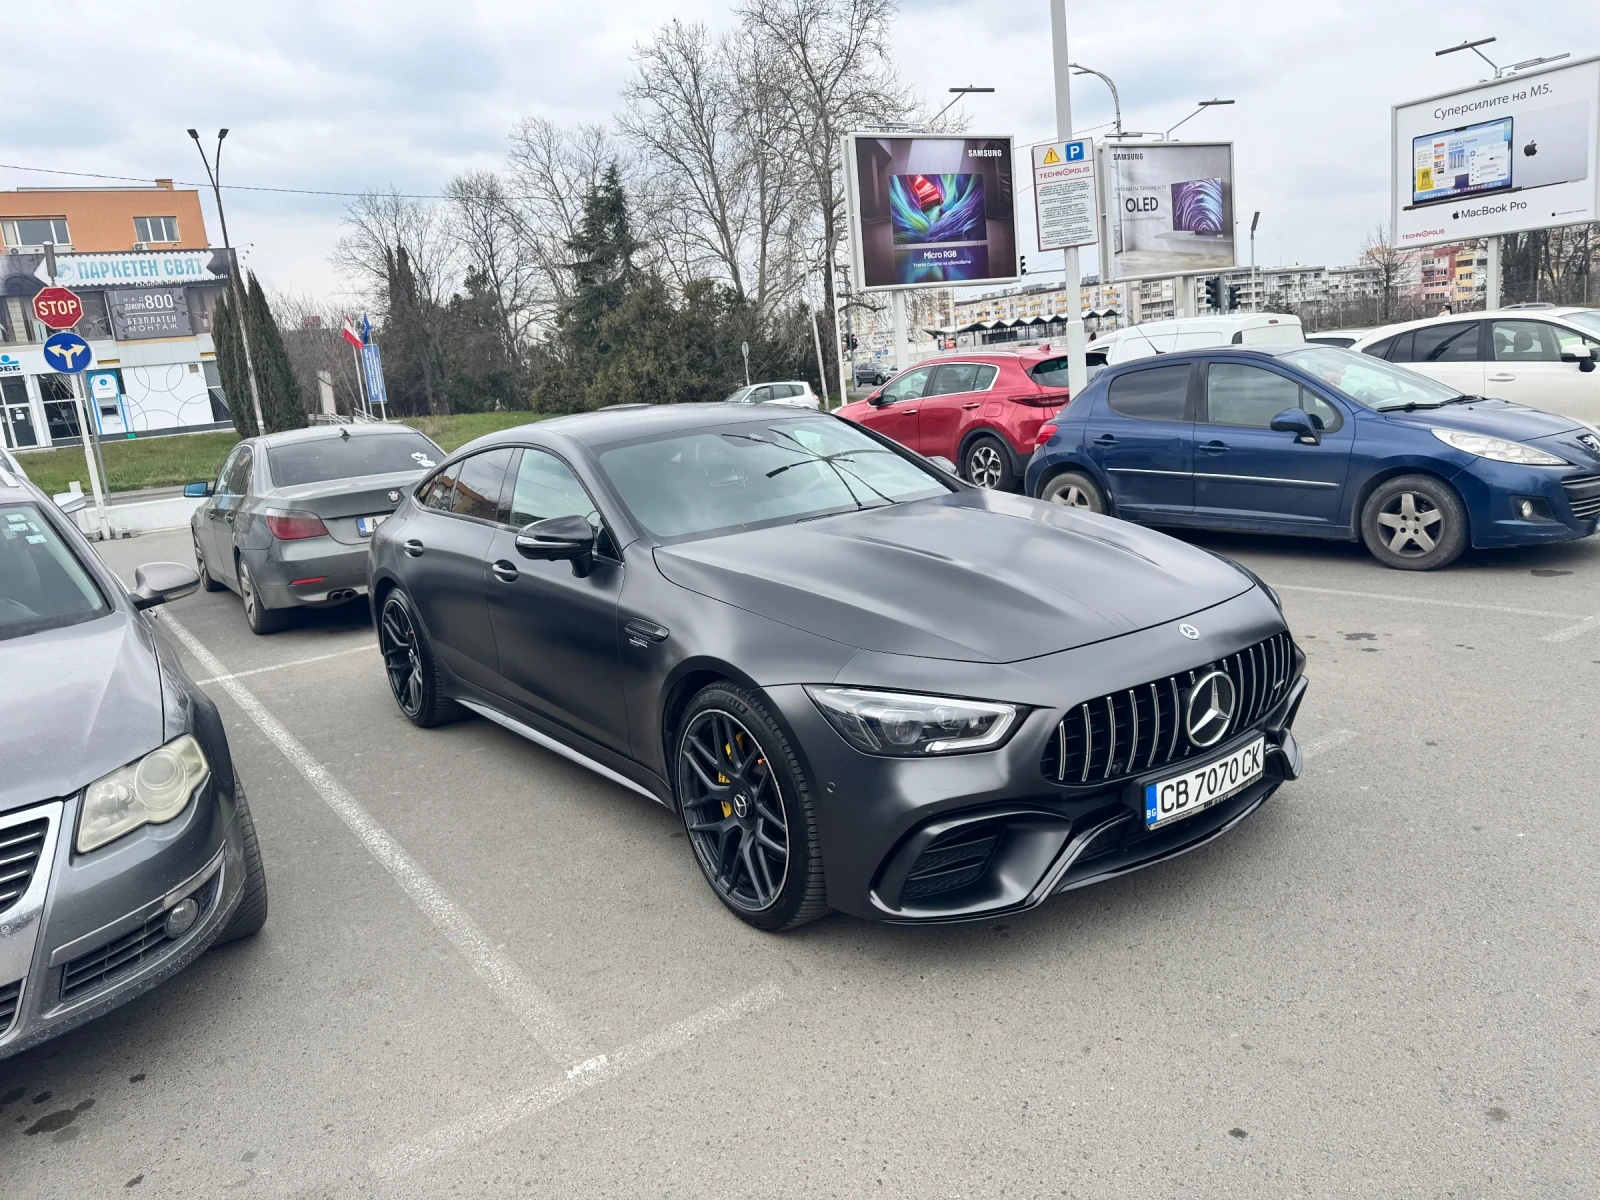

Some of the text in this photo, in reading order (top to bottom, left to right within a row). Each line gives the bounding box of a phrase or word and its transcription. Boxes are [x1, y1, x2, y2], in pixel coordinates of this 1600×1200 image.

[1433, 94, 1509, 121] Суперсилите
[1512, 92, 1527, 101] на
[967, 149, 1002, 157] SAMSUNG
[1113, 153, 1144, 161] SAMSUNG
[1039, 166, 1090, 179] TECHNOPOLIS
[1125, 196, 1159, 213] OLED
[1460, 200, 1528, 219] MacBook Pro
[1402, 228, 1445, 240] TECHNOPOLIS
[923, 250, 957, 259] Micro RGB
[77, 260, 159, 280] ПАРКЕТЕН
[163, 257, 203, 275] СВЯТ
[145, 293, 174, 309] 800
[38, 300, 77, 316] STOP
[127, 315, 177, 325] БЕЗПЛАТЕН
[129, 323, 178, 332] МОНТАЖ
[1160, 778, 1189, 814] CB
[1194, 757, 1239, 803] 7070
[1241, 743, 1261, 777] CK
[1146, 808, 1157, 819] BG
